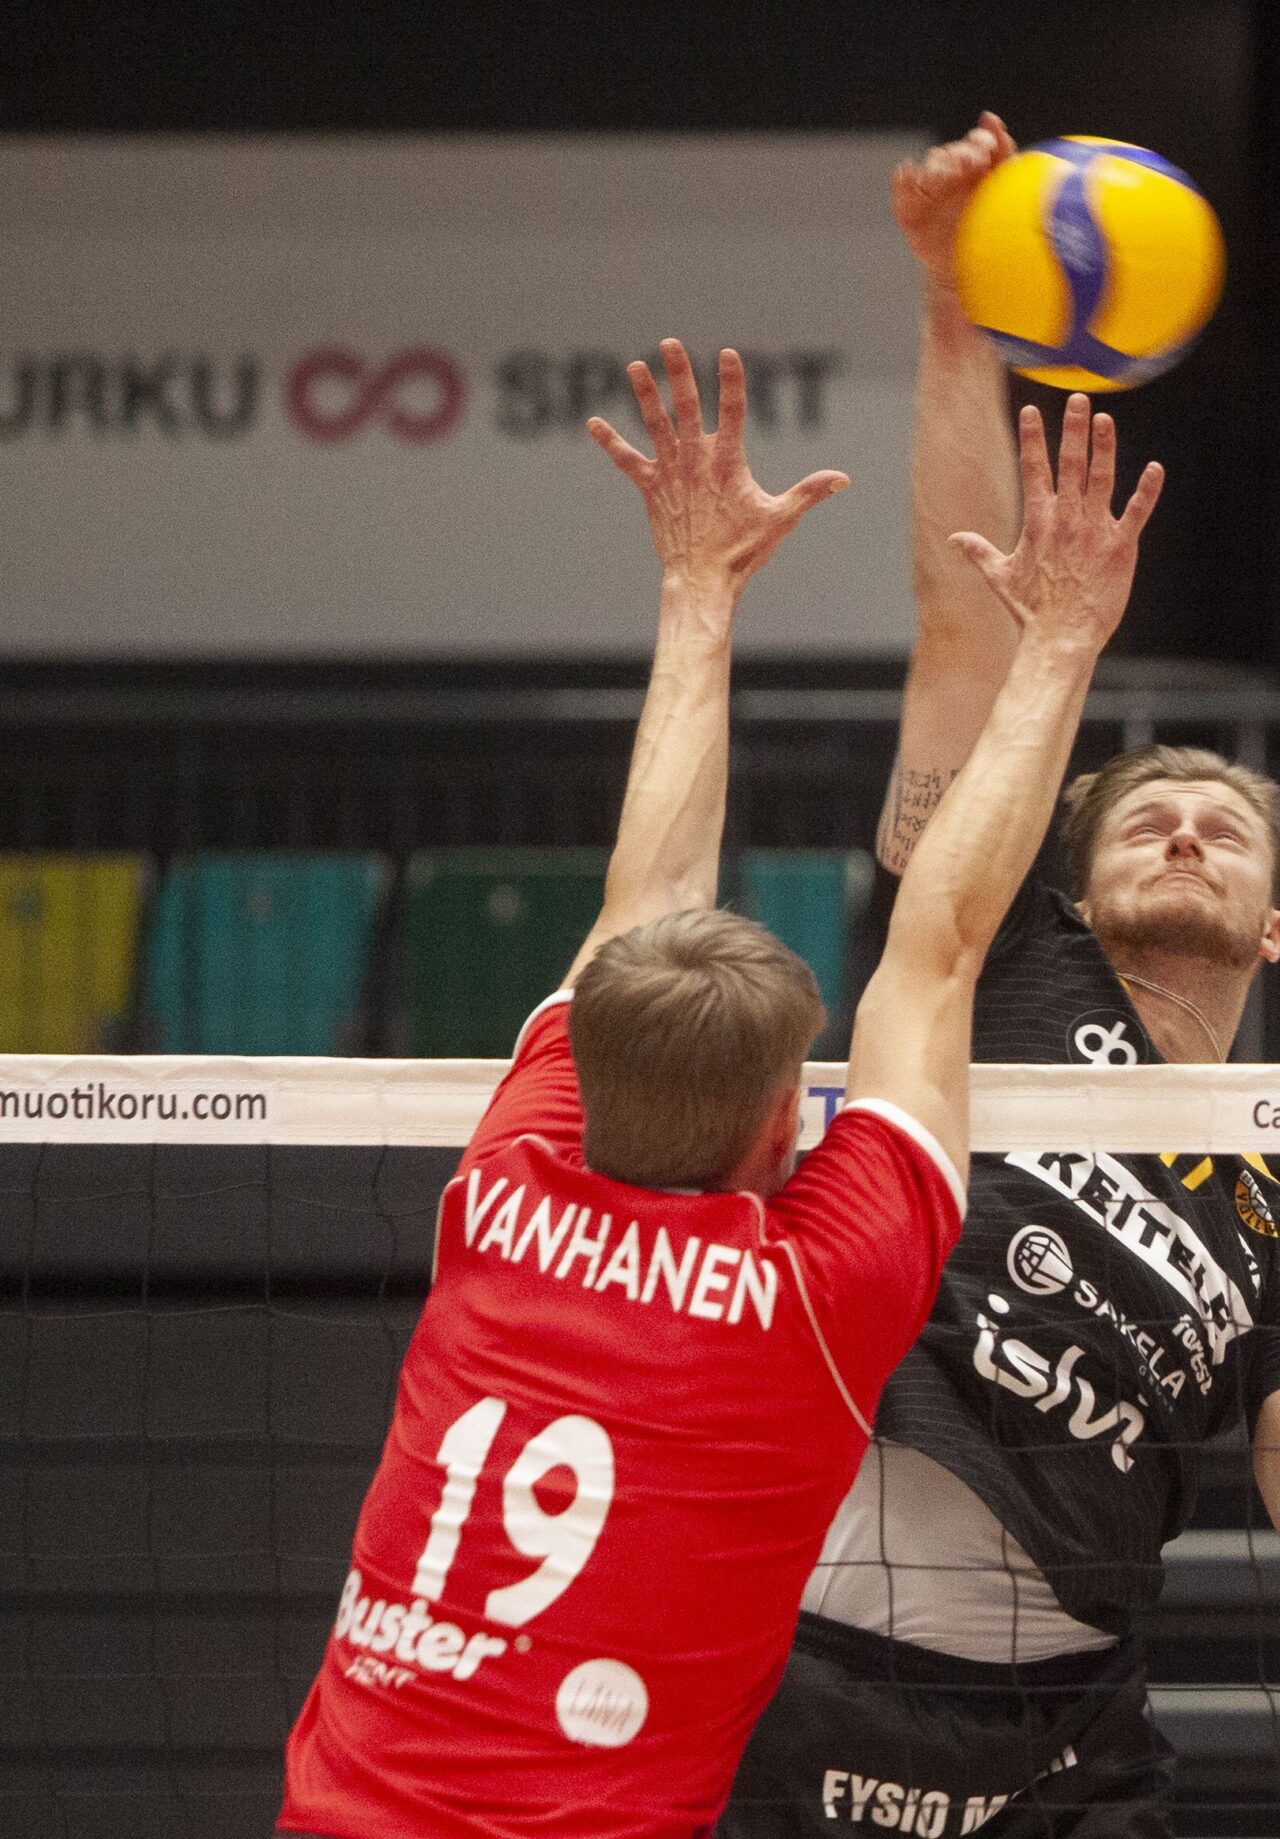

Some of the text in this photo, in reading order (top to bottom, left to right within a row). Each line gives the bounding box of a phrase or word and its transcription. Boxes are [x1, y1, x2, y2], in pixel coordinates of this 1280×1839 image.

[464, 1169, 778, 1331] VANHANEN
[411, 1396, 616, 1629] 19
[821, 1768, 951, 1839] FYSIO
